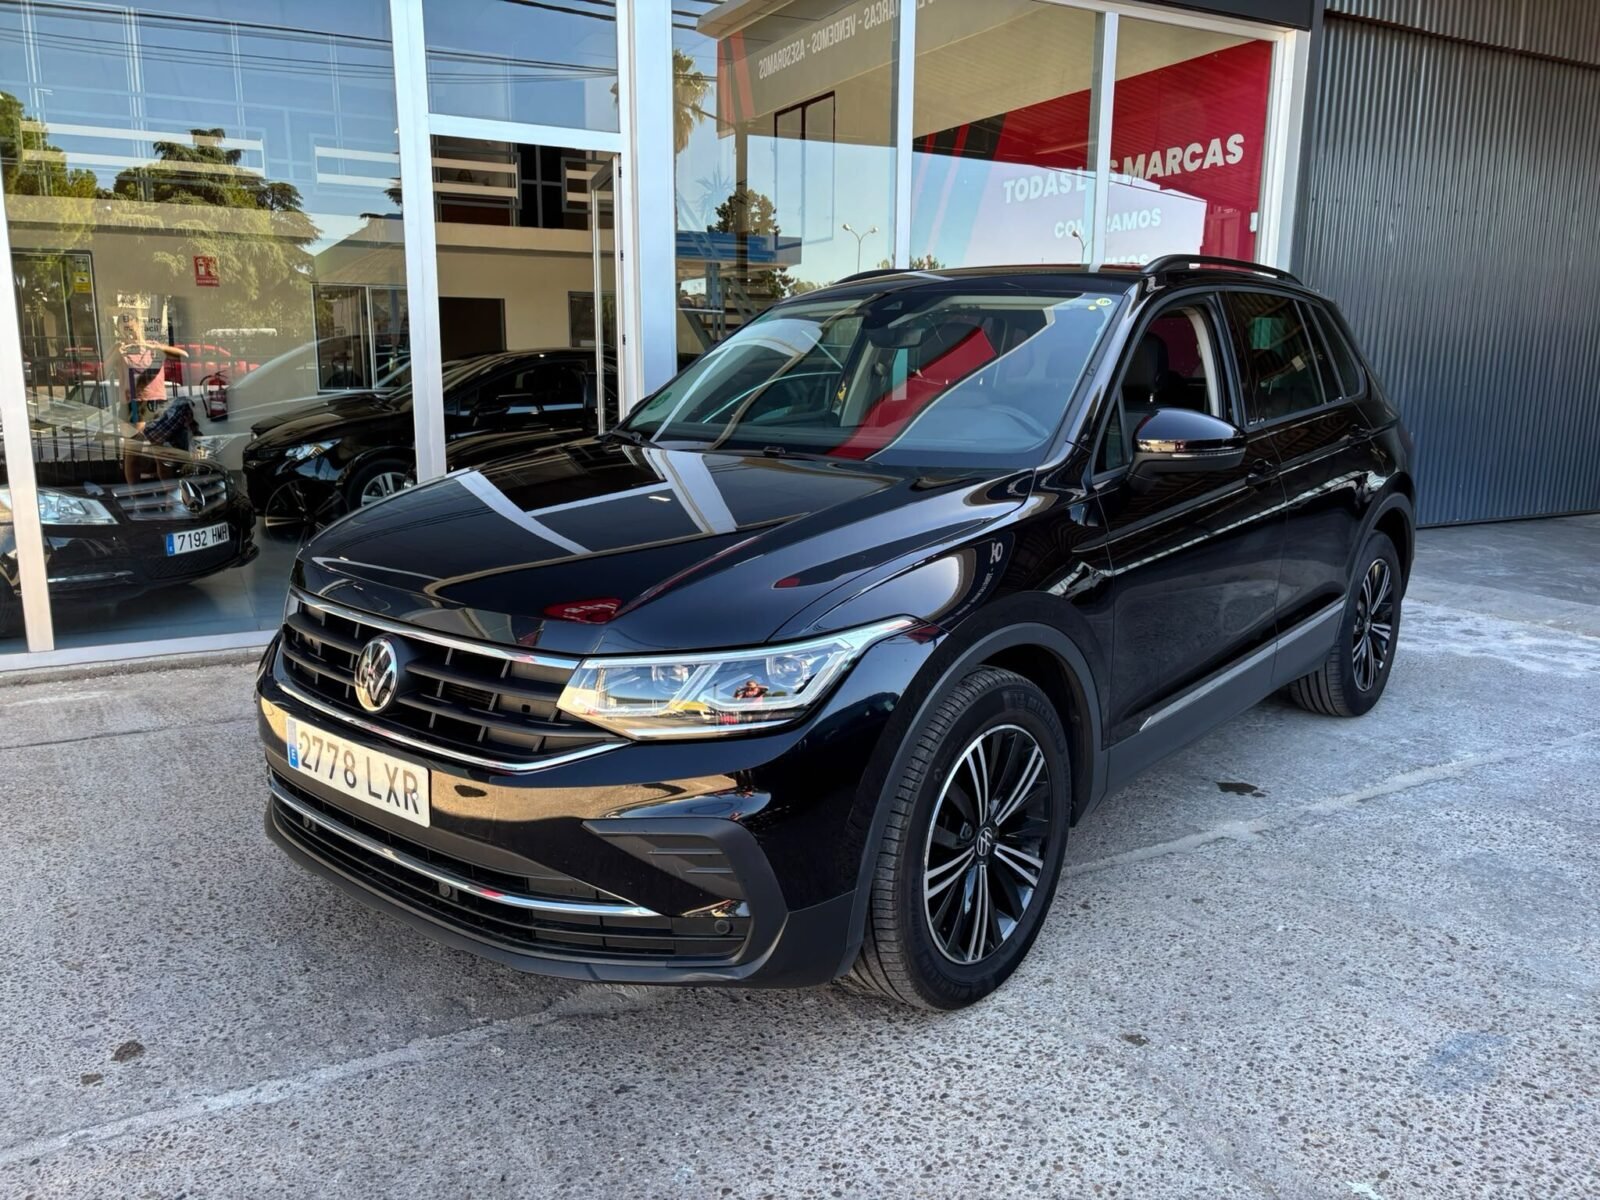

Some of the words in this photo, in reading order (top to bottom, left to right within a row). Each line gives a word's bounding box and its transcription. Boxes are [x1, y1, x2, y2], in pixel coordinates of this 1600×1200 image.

[1003, 173, 1072, 204] TODAS
[1123, 133, 1245, 184] MARCAS
[178, 530, 208, 551] 7192
[299, 730, 357, 789] 2778
[366, 756, 420, 815] LXR
